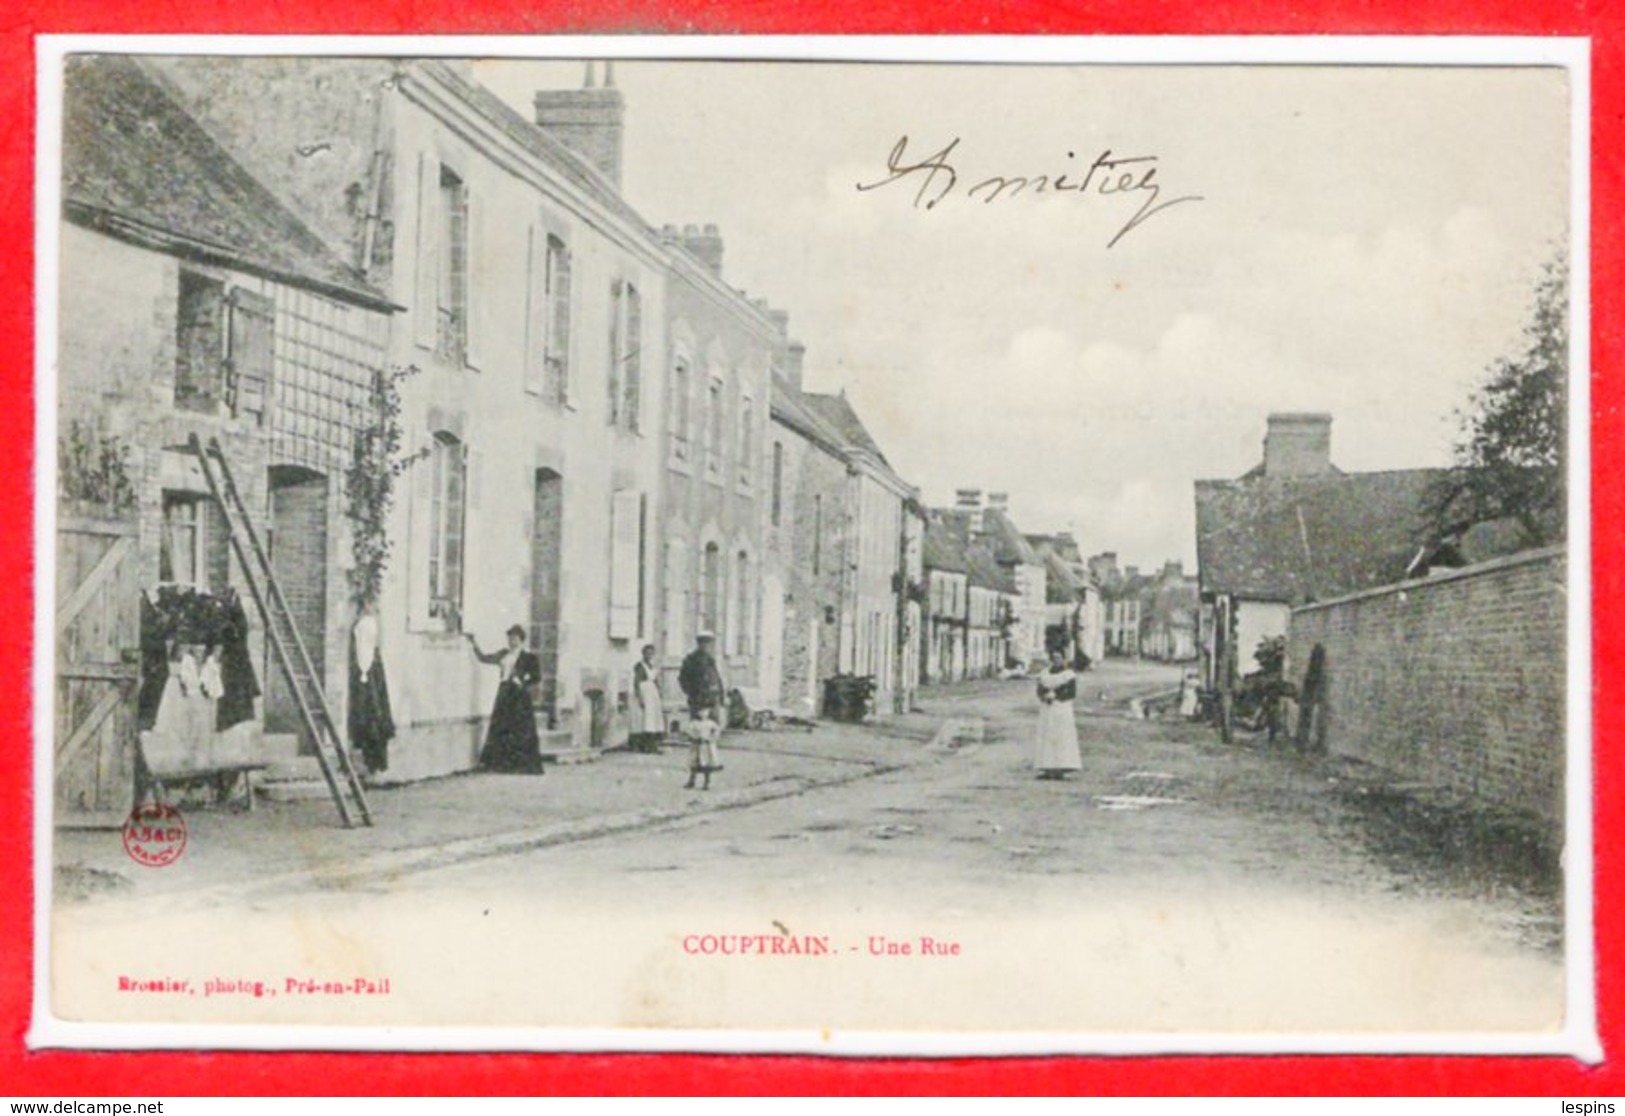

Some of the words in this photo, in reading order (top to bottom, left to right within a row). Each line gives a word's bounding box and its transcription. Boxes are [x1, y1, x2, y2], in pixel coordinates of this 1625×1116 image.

[682, 934, 839, 956] COUPTRAIN.
[867, 936, 912, 957] Une
[919, 936, 962, 957] Rue
